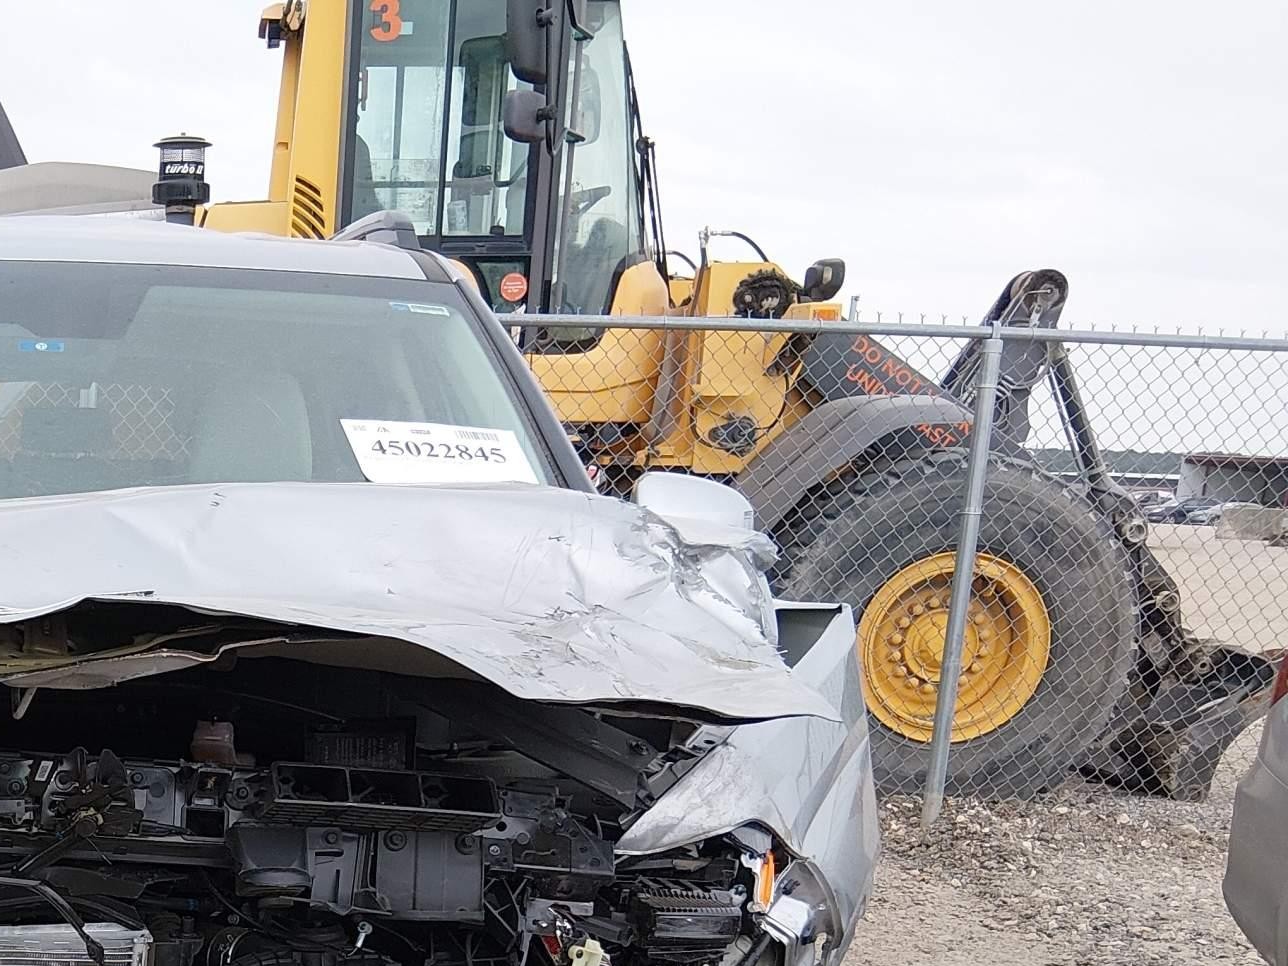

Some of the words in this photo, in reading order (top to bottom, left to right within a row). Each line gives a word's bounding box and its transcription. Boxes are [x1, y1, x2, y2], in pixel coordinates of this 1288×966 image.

[369, 0, 400, 41] 3
[165, 163, 195, 174] turbo
[852, 334, 881, 363] DO
[881, 358, 921, 393] NOT
[371, 439, 506, 464] 45022845
